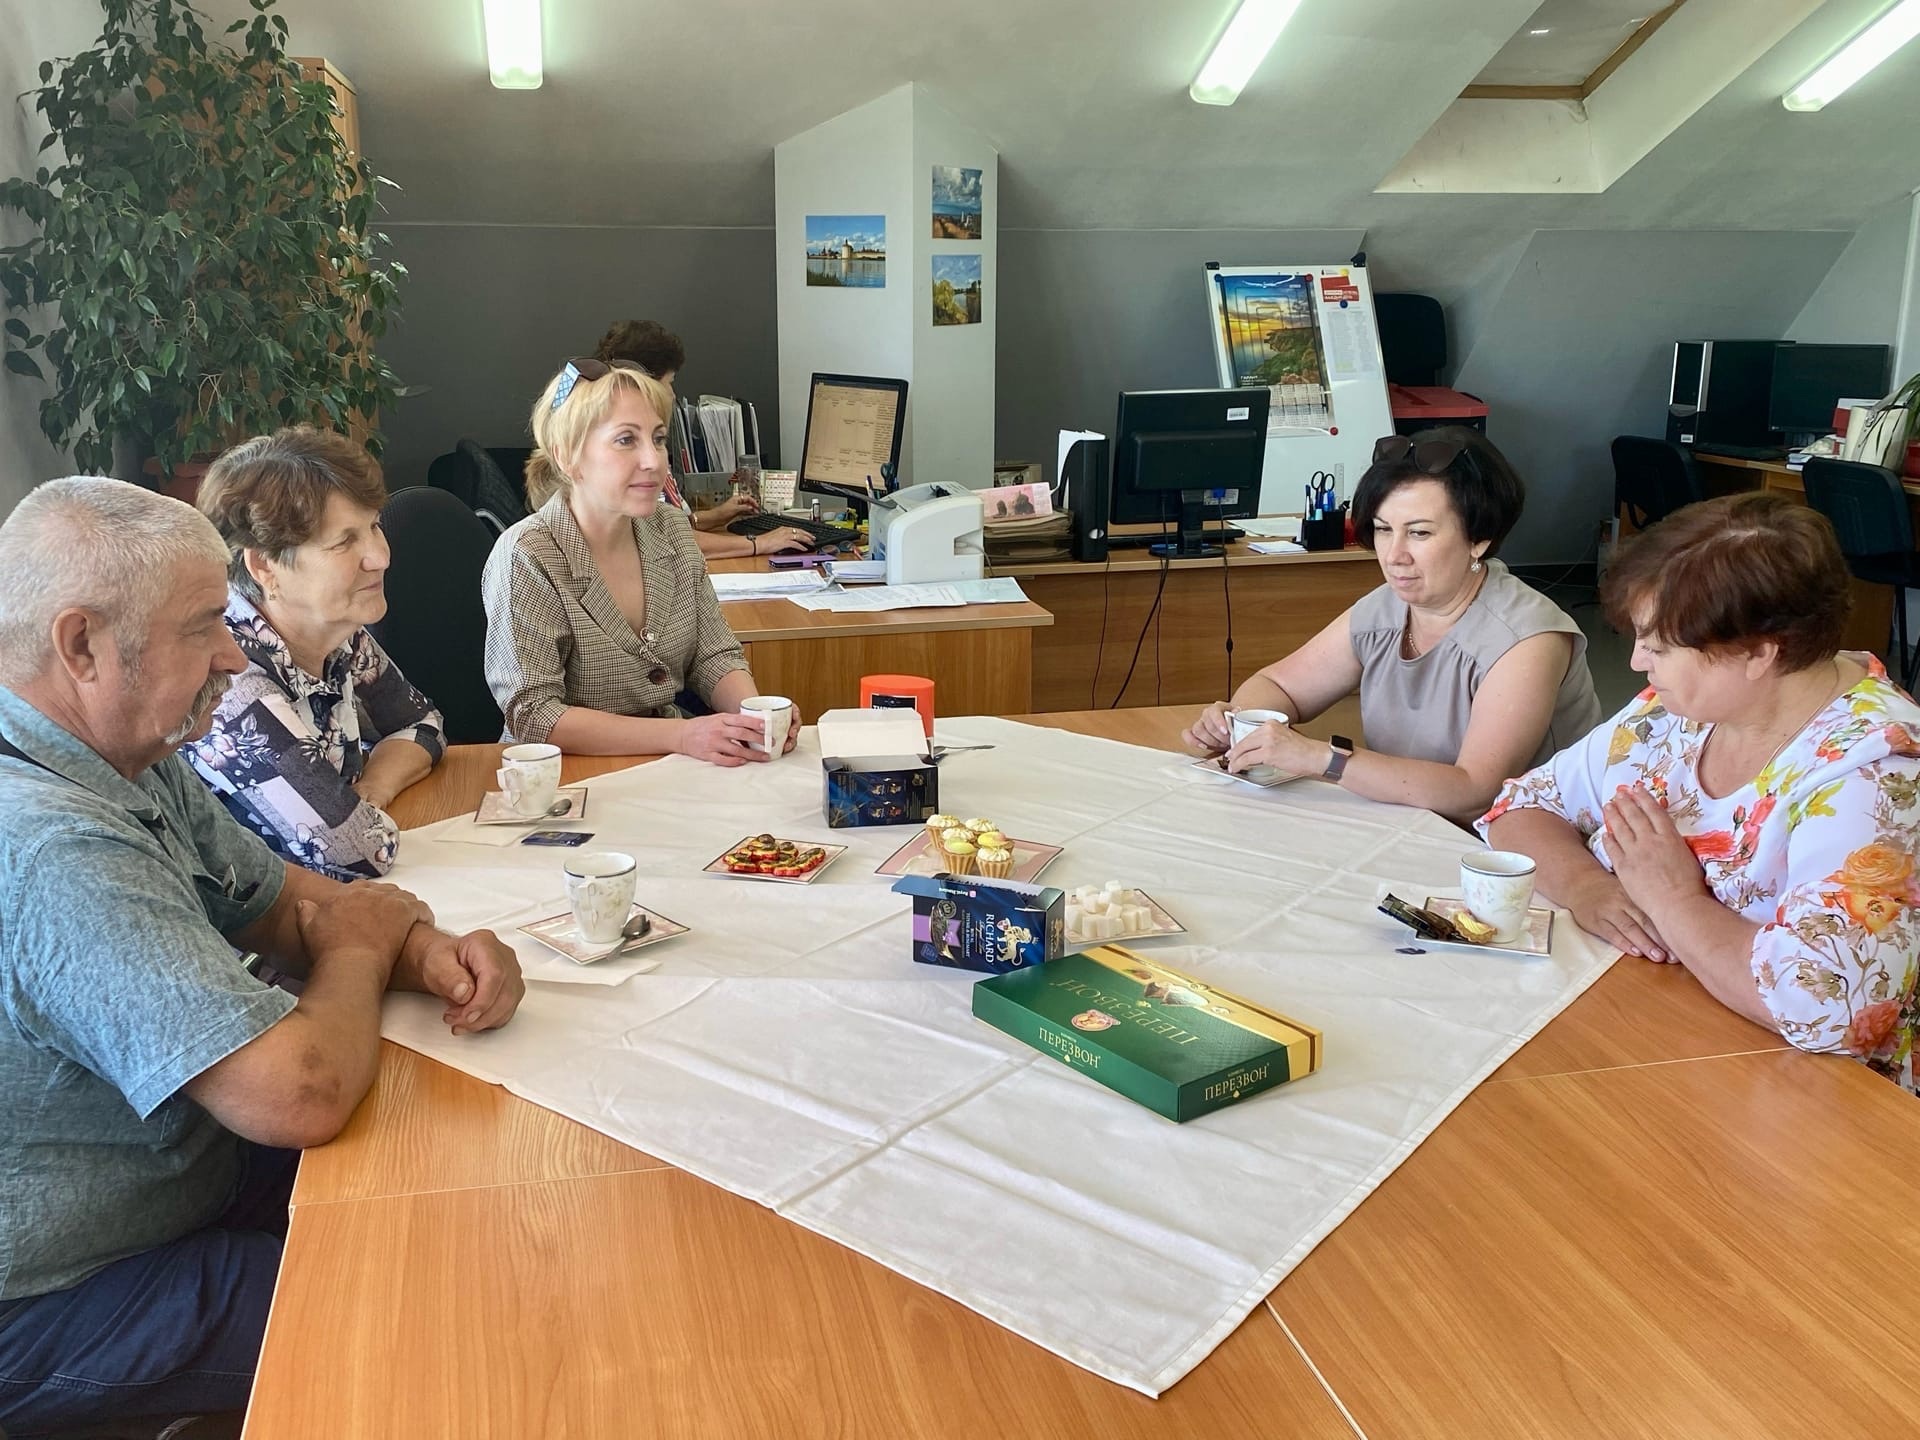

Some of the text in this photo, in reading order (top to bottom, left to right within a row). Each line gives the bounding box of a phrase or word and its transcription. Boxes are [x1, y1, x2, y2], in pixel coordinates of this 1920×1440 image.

[985, 913, 995, 963] RICHARD
[1056, 979, 1200, 1045] ПЕРЕЗВОН
[1039, 1027, 1099, 1068] ПЕРЕЗВОН
[1205, 1065, 1268, 1101] ПЕРЕЗВОН
